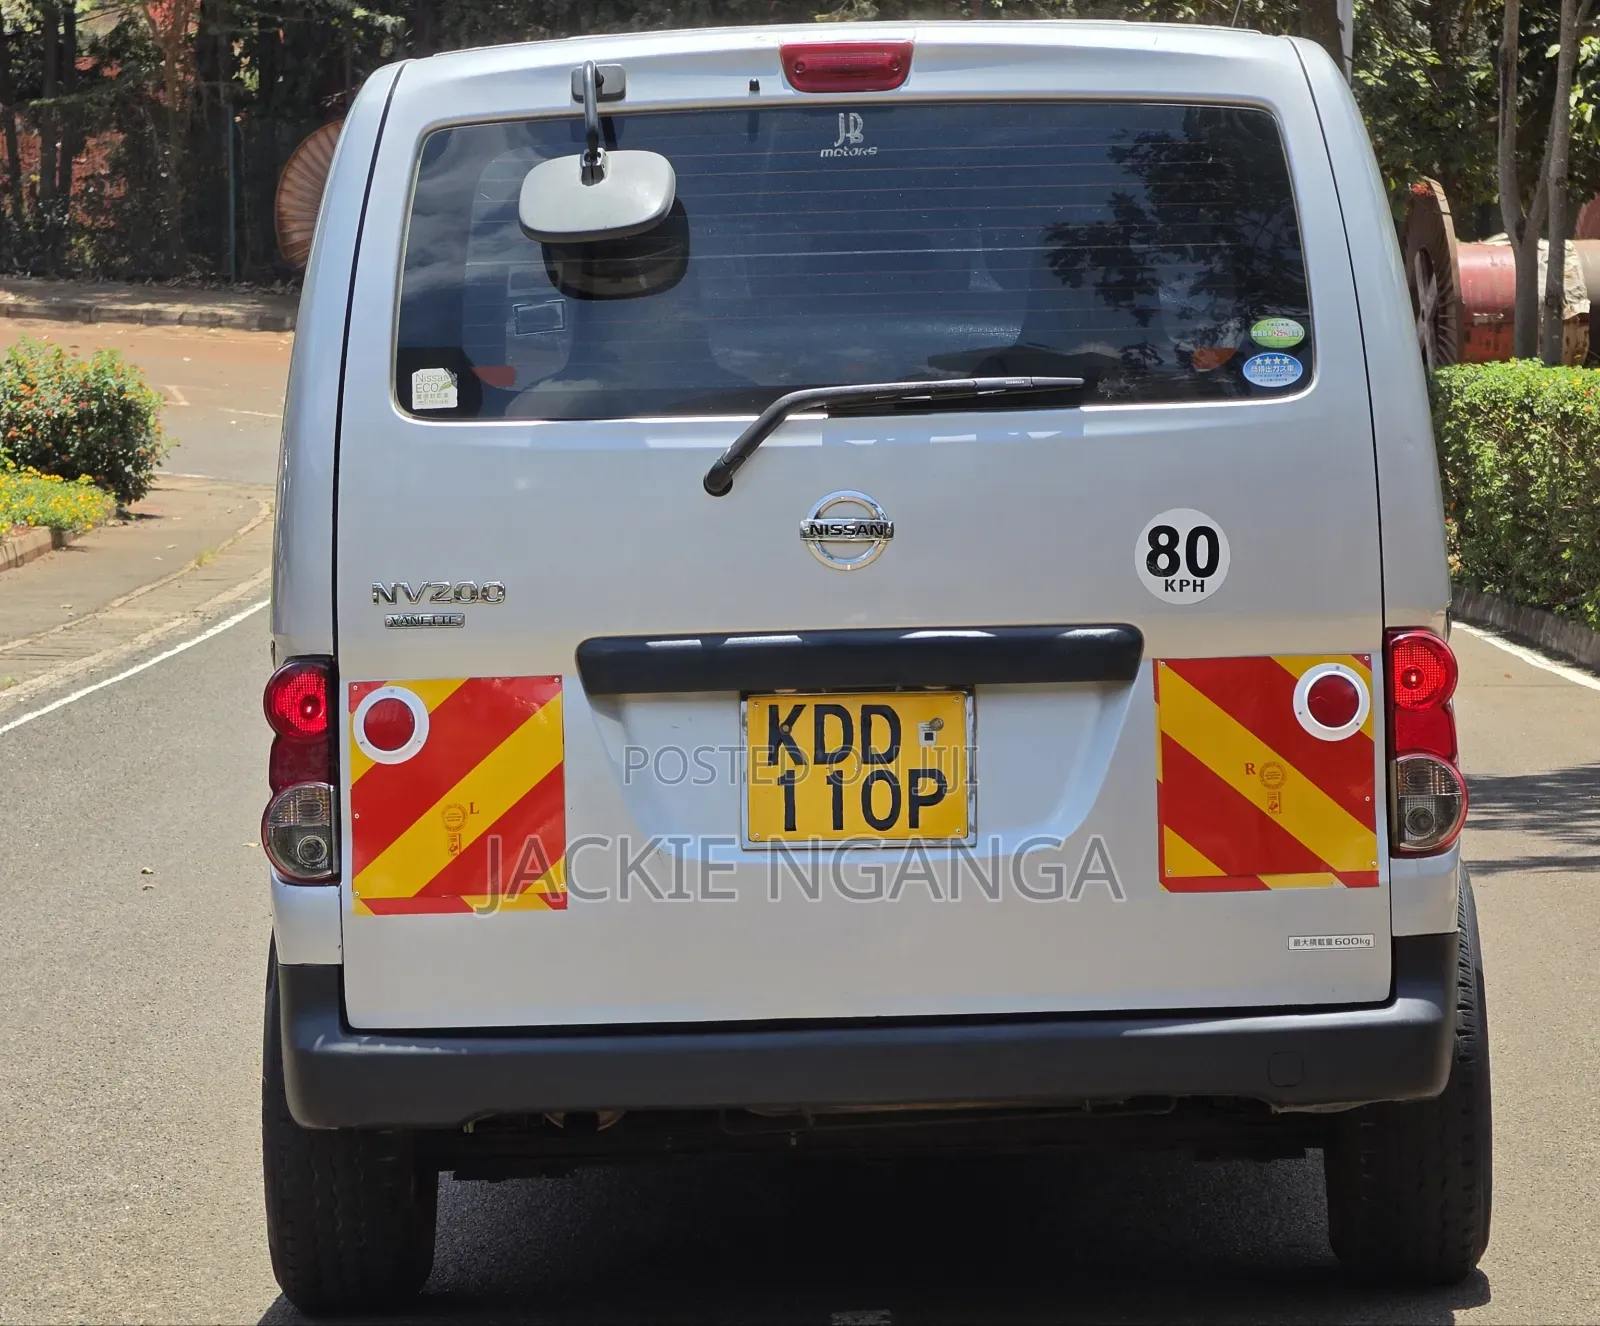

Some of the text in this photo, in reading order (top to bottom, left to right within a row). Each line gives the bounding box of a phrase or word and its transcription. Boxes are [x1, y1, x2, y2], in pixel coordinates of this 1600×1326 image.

[415, 373, 450, 383] Nissan
[416, 382, 439, 393] ECO
[809, 524, 884, 536] NISSAN
[1146, 525, 1220, 578] 80
[1164, 579, 1205, 593] KPH
[372, 581, 506, 605] NV200
[391, 616, 457, 626] VANETTE
[767, 704, 902, 766] KDD
[1244, 762, 1256, 775] R
[777, 769, 948, 831] 110P
[469, 802, 480, 815] L
